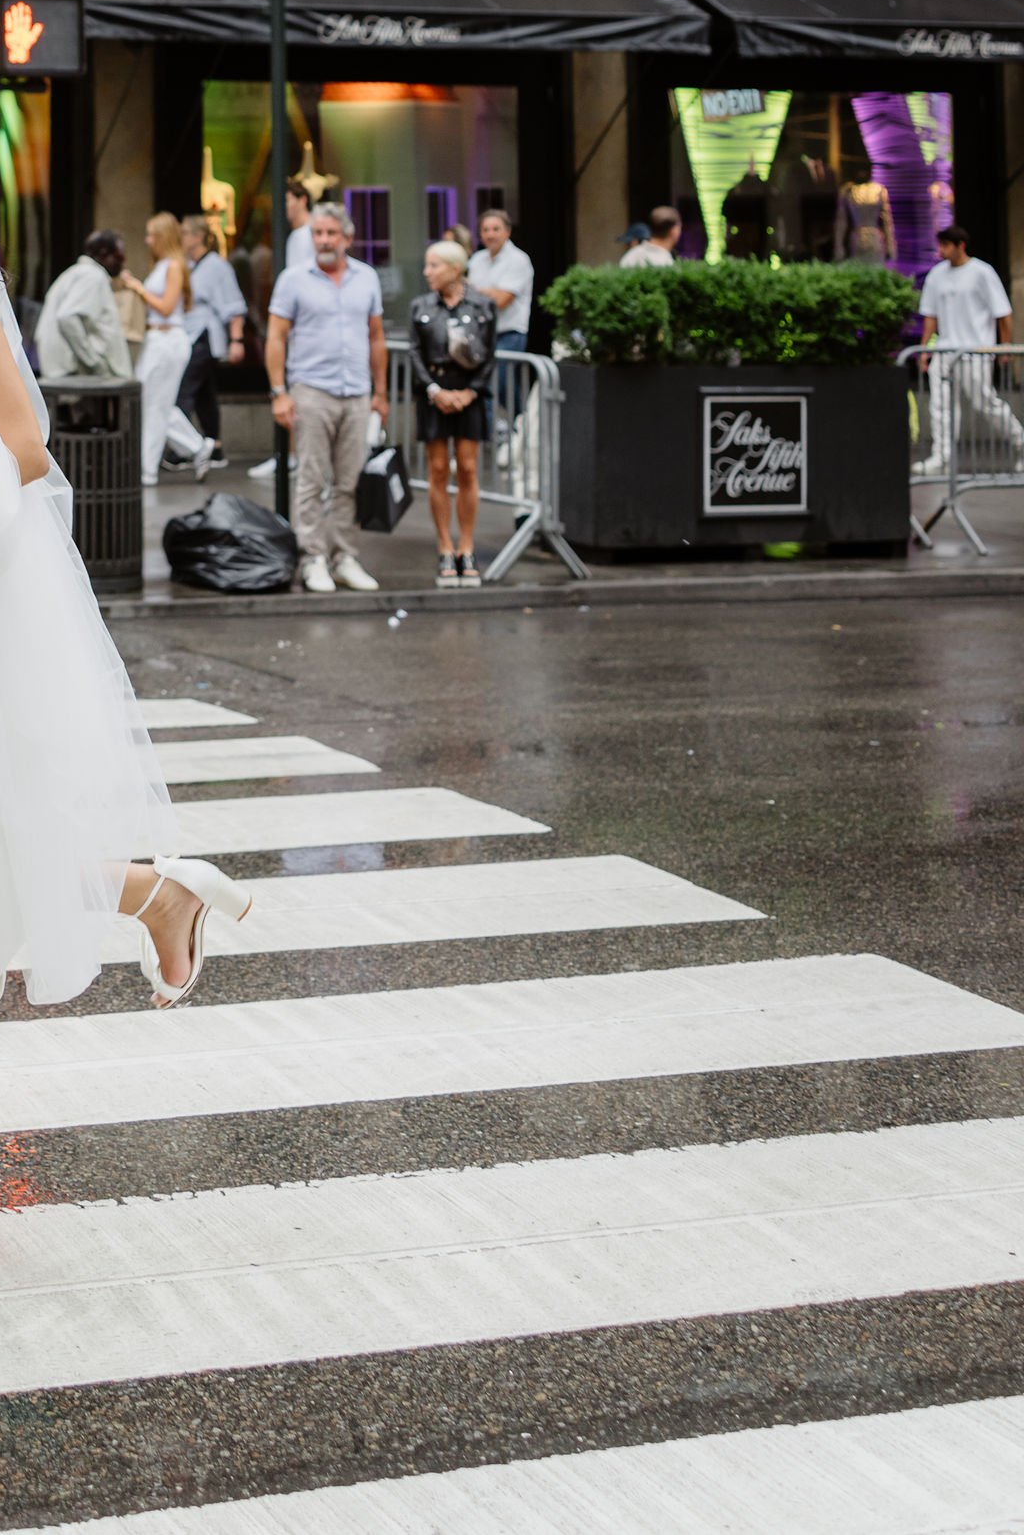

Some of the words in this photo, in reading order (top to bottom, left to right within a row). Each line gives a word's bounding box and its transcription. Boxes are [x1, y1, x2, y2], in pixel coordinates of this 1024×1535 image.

[711, 410, 771, 455] Saks
[711, 456, 796, 498] Avenue
[740, 437, 802, 475] Fifth
